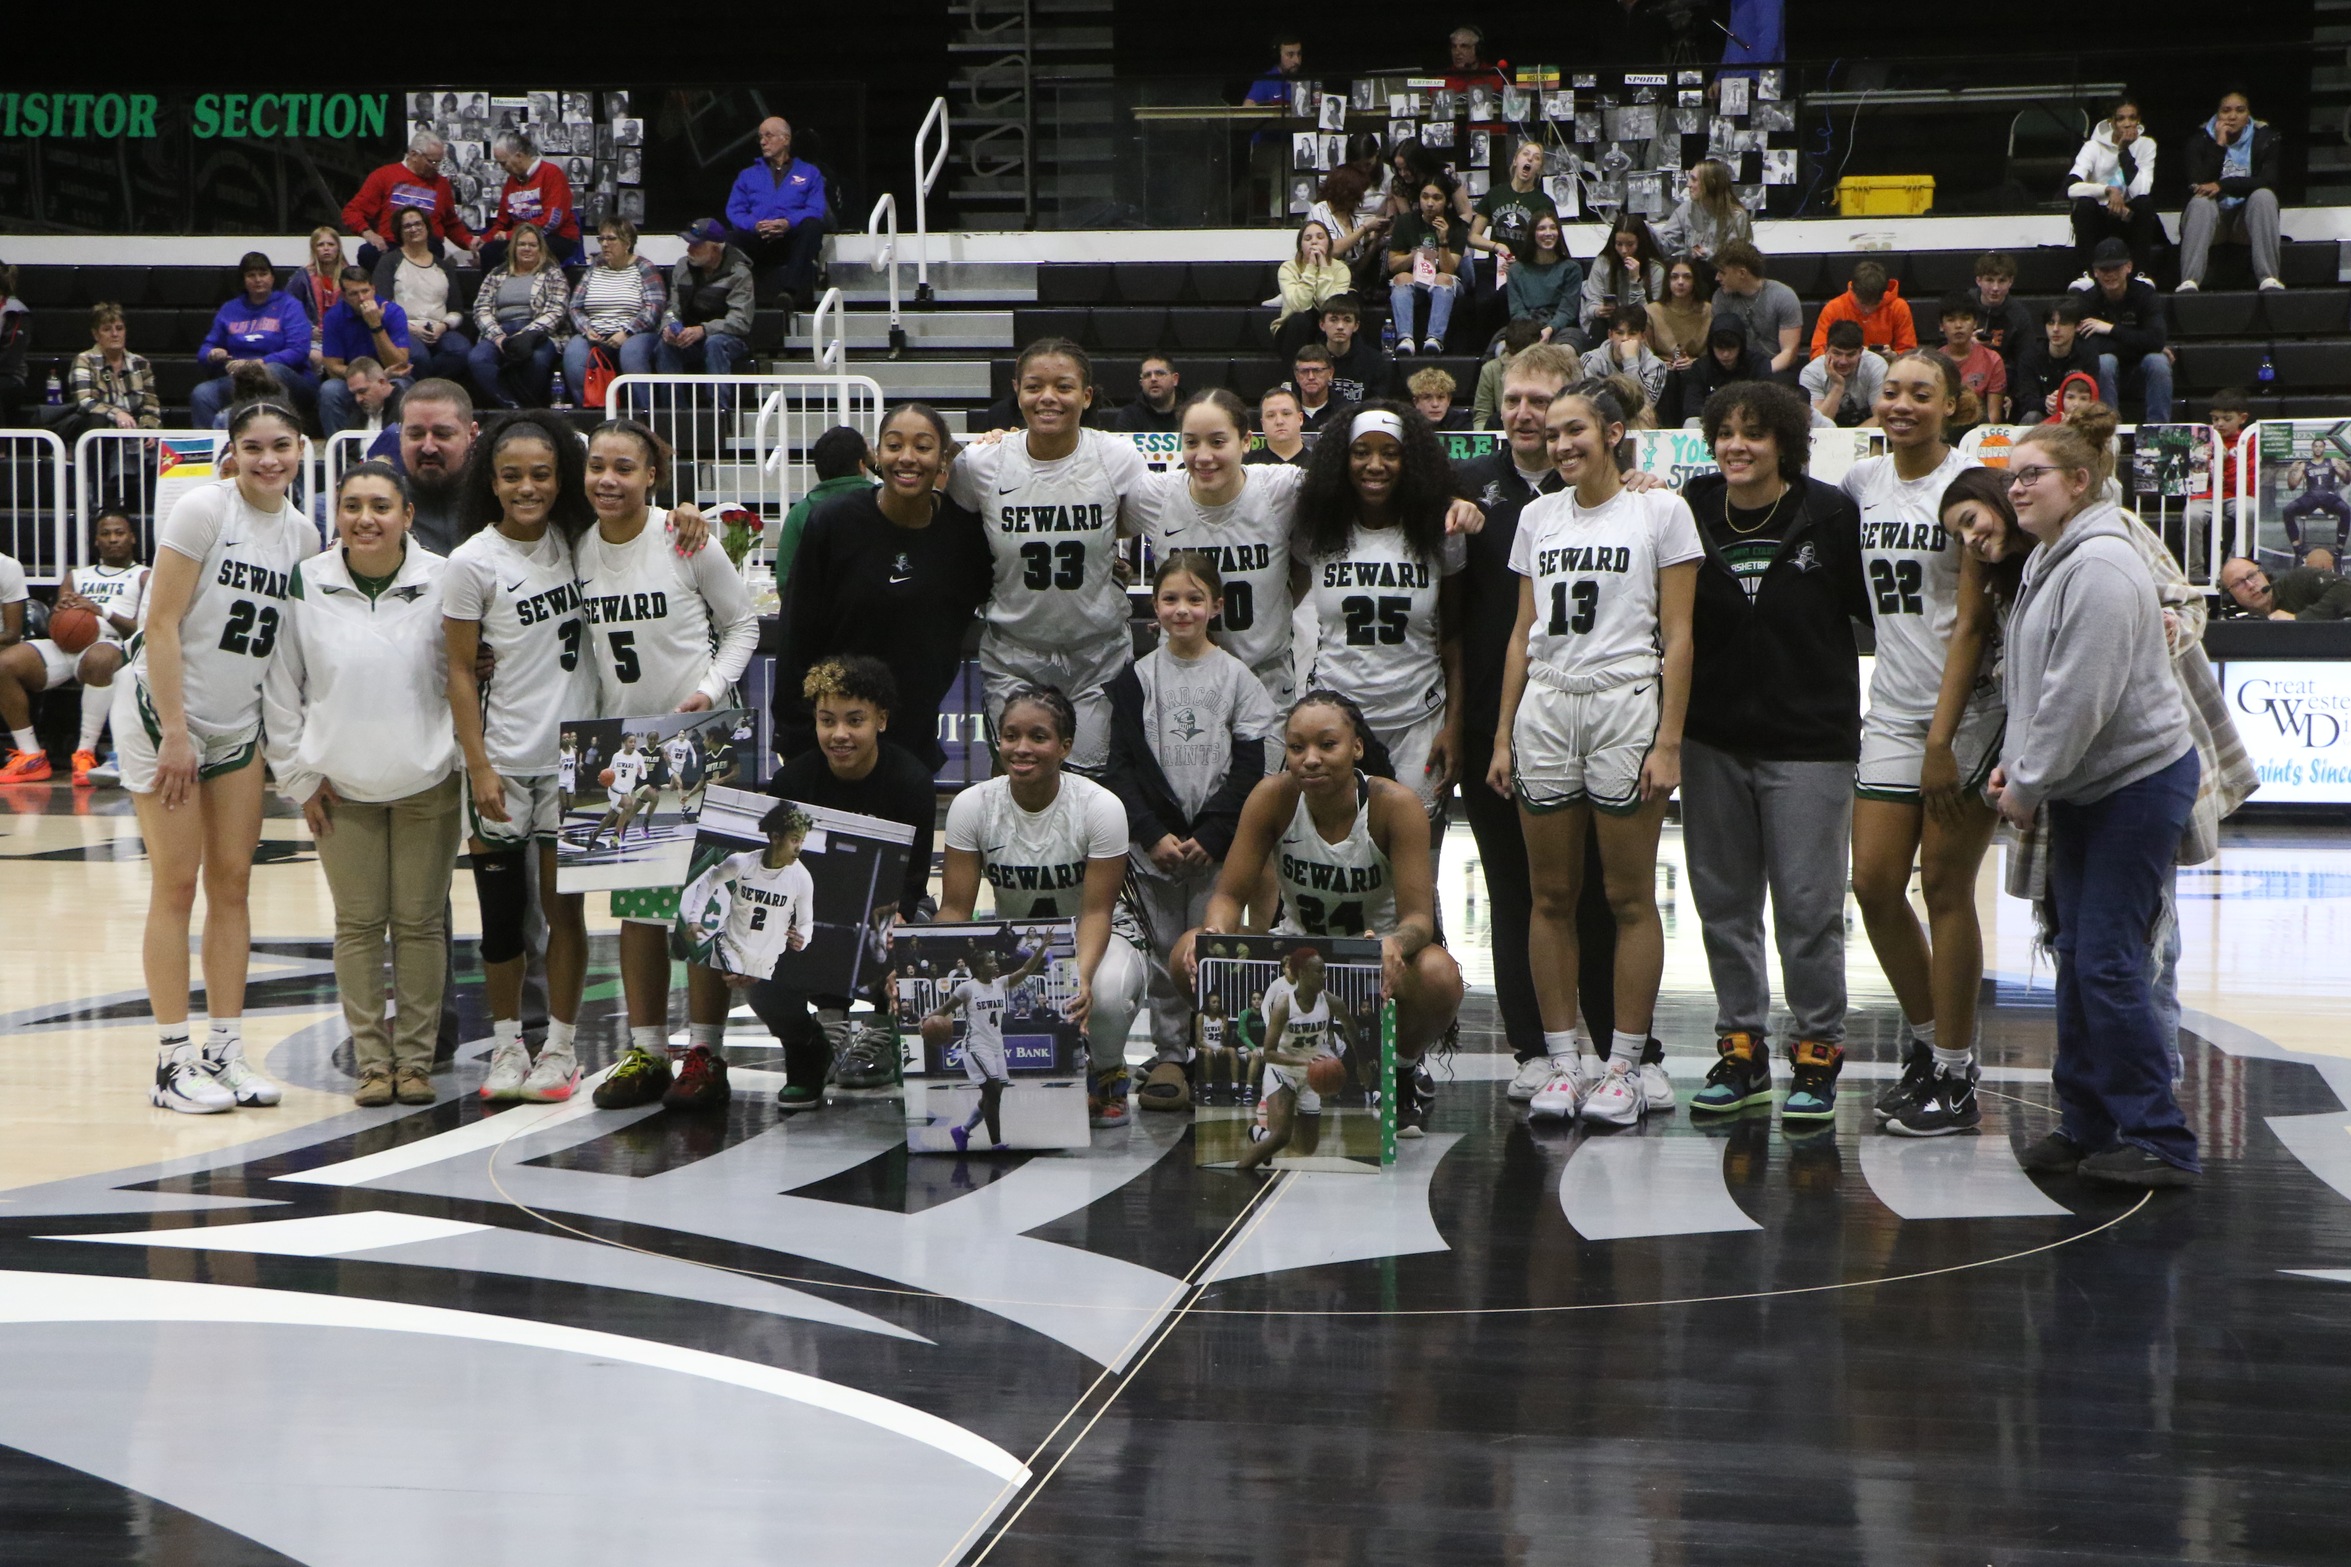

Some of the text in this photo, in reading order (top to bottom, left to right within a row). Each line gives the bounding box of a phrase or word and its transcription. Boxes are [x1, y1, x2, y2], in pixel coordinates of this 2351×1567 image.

[0, 92, 389, 139] ISITOR SECTION
[1001, 503, 1103, 533] SEWARD
[1860, 521, 1946, 552] SEWARD
[1020, 540, 1086, 591] 33
[1169, 543, 1270, 572] WARD
[1538, 547, 1631, 577] SEWARD
[80, 582, 125, 595] SAINTS
[1323, 562, 1430, 589] SEWARD
[1868, 559, 1924, 615] 22
[583, 591, 669, 625] SEWARD
[1341, 596, 1411, 645] 25
[1548, 580, 1600, 636] 13
[218, 599, 280, 658] 23
[608, 630, 641, 684] 5
[2237, 678, 2316, 715] Great
[621, 769, 628, 778] 5
[2254, 758, 2303, 786] aints
[1283, 853, 1382, 893] SEWARD
[741, 885, 788, 908] SEWARD
[750, 906, 767, 931] 2
[1296, 893, 1365, 936] 24
[989, 1011, 998, 1028] 4
[1016, 1047, 1051, 1058] BANK
